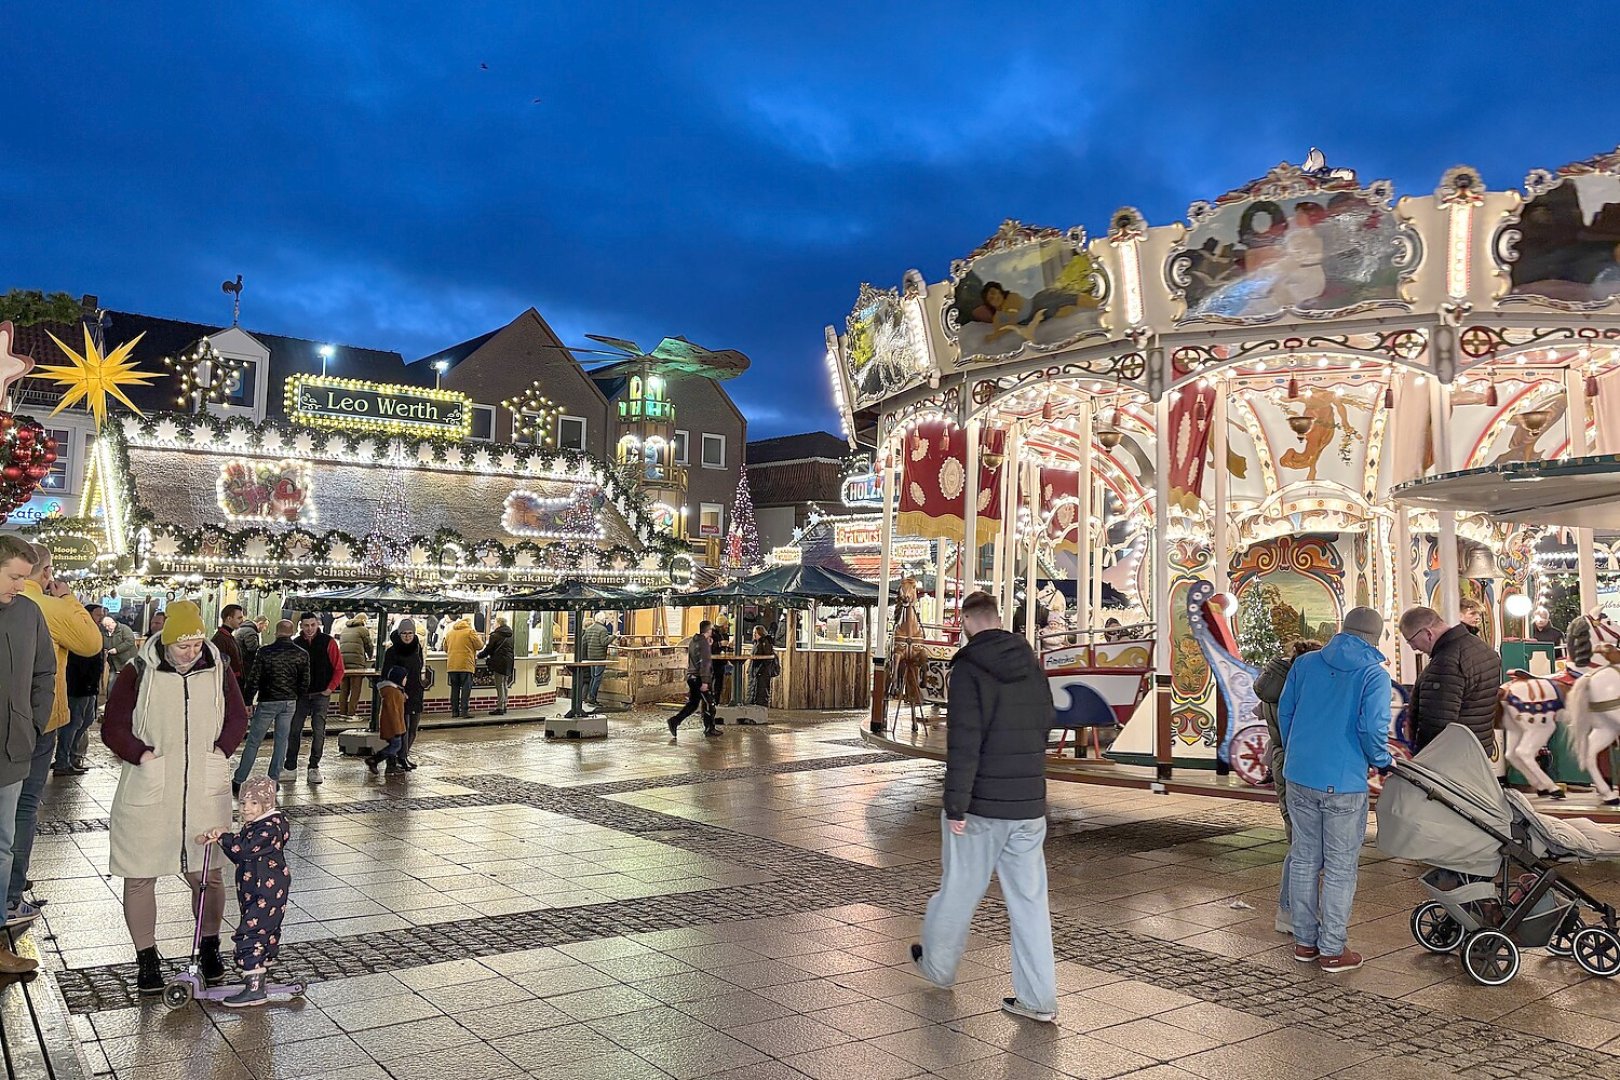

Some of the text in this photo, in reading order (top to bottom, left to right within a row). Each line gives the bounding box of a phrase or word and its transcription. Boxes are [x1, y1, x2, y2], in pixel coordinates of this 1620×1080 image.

[327, 391, 438, 420] Leo Werth
[838, 527, 882, 544] Bratwurst
[53, 546, 78, 555] Mooje
[160, 561, 201, 573] Thür.
[204, 563, 280, 575] Bratwurst
[414, 569, 479, 582] Hamger
[585, 576, 625, 585] Pommes
